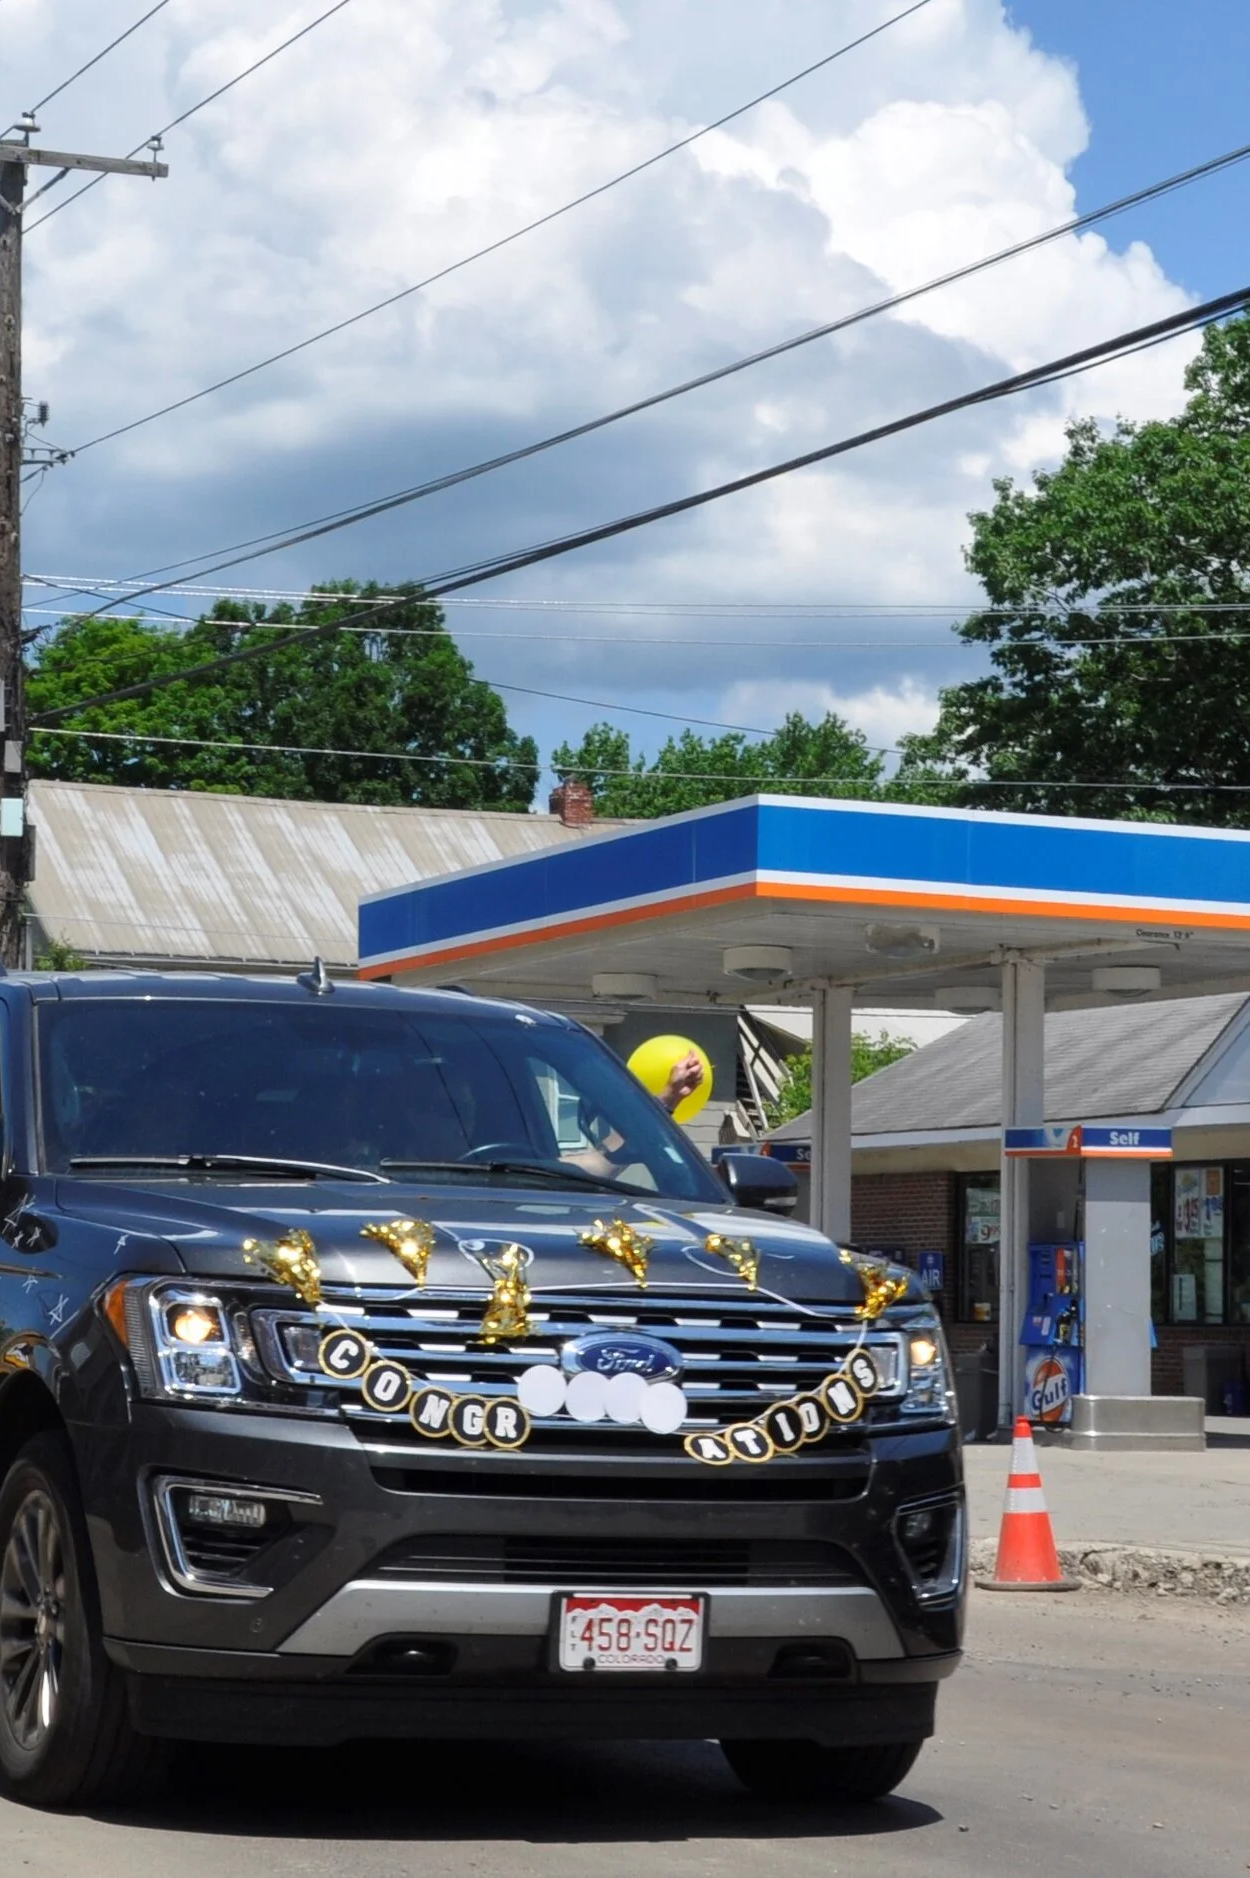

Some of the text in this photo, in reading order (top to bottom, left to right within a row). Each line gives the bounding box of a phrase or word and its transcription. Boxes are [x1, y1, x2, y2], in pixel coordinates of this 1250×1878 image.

[1110, 1132, 1140, 1145] Self
[796, 1141, 811, 1160] Se
[922, 1268, 940, 1286] AIR
[597, 1347, 655, 1372] Ford
[1032, 1377, 1067, 1411] Gulf
[597, 1654, 665, 1664] COLORADO
